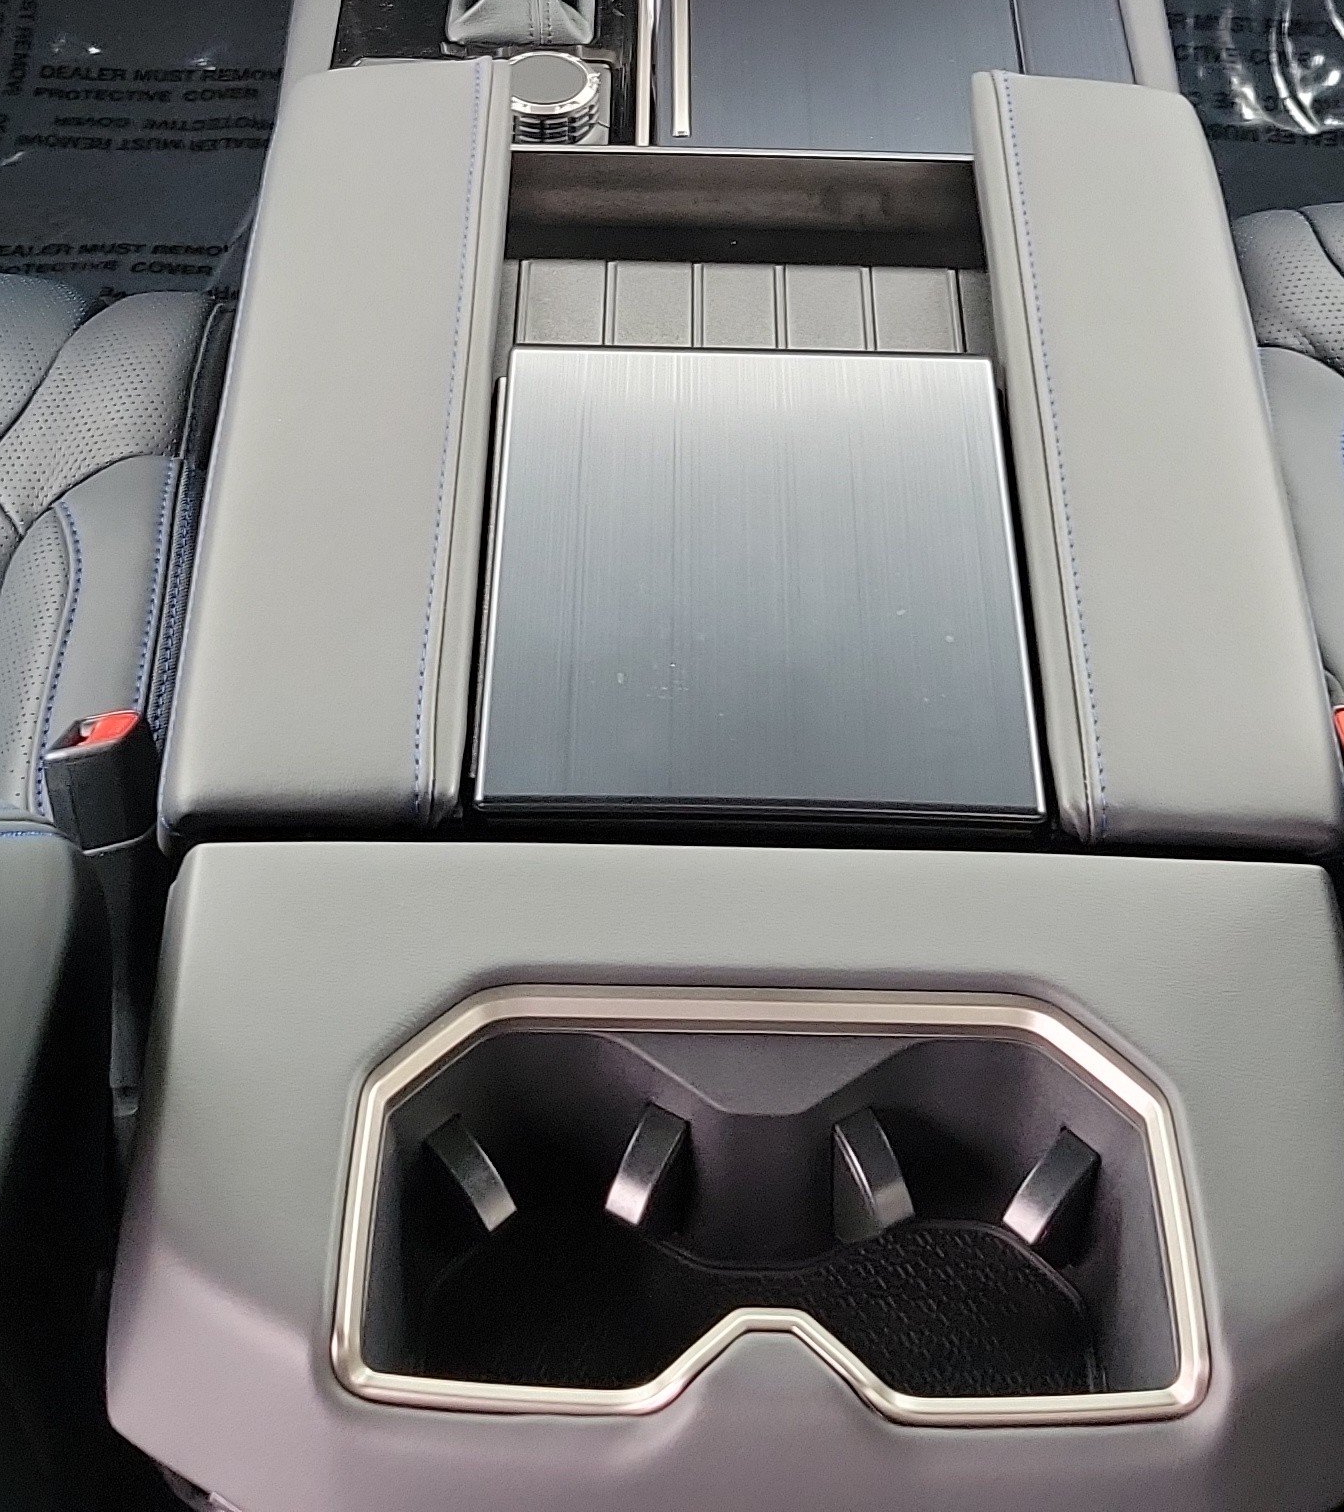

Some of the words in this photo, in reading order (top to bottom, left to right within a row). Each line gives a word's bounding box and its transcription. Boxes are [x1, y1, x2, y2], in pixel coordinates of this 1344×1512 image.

[39, 64, 127, 82] DEALER
[132, 67, 194, 82] MUST
[201, 67, 282, 83] REMOV
[33, 87, 172, 103] PROTECTIVE
[182, 87, 259, 103] COVER
[76, 243, 148, 257] MUST
[129, 261, 214, 277] COVER
